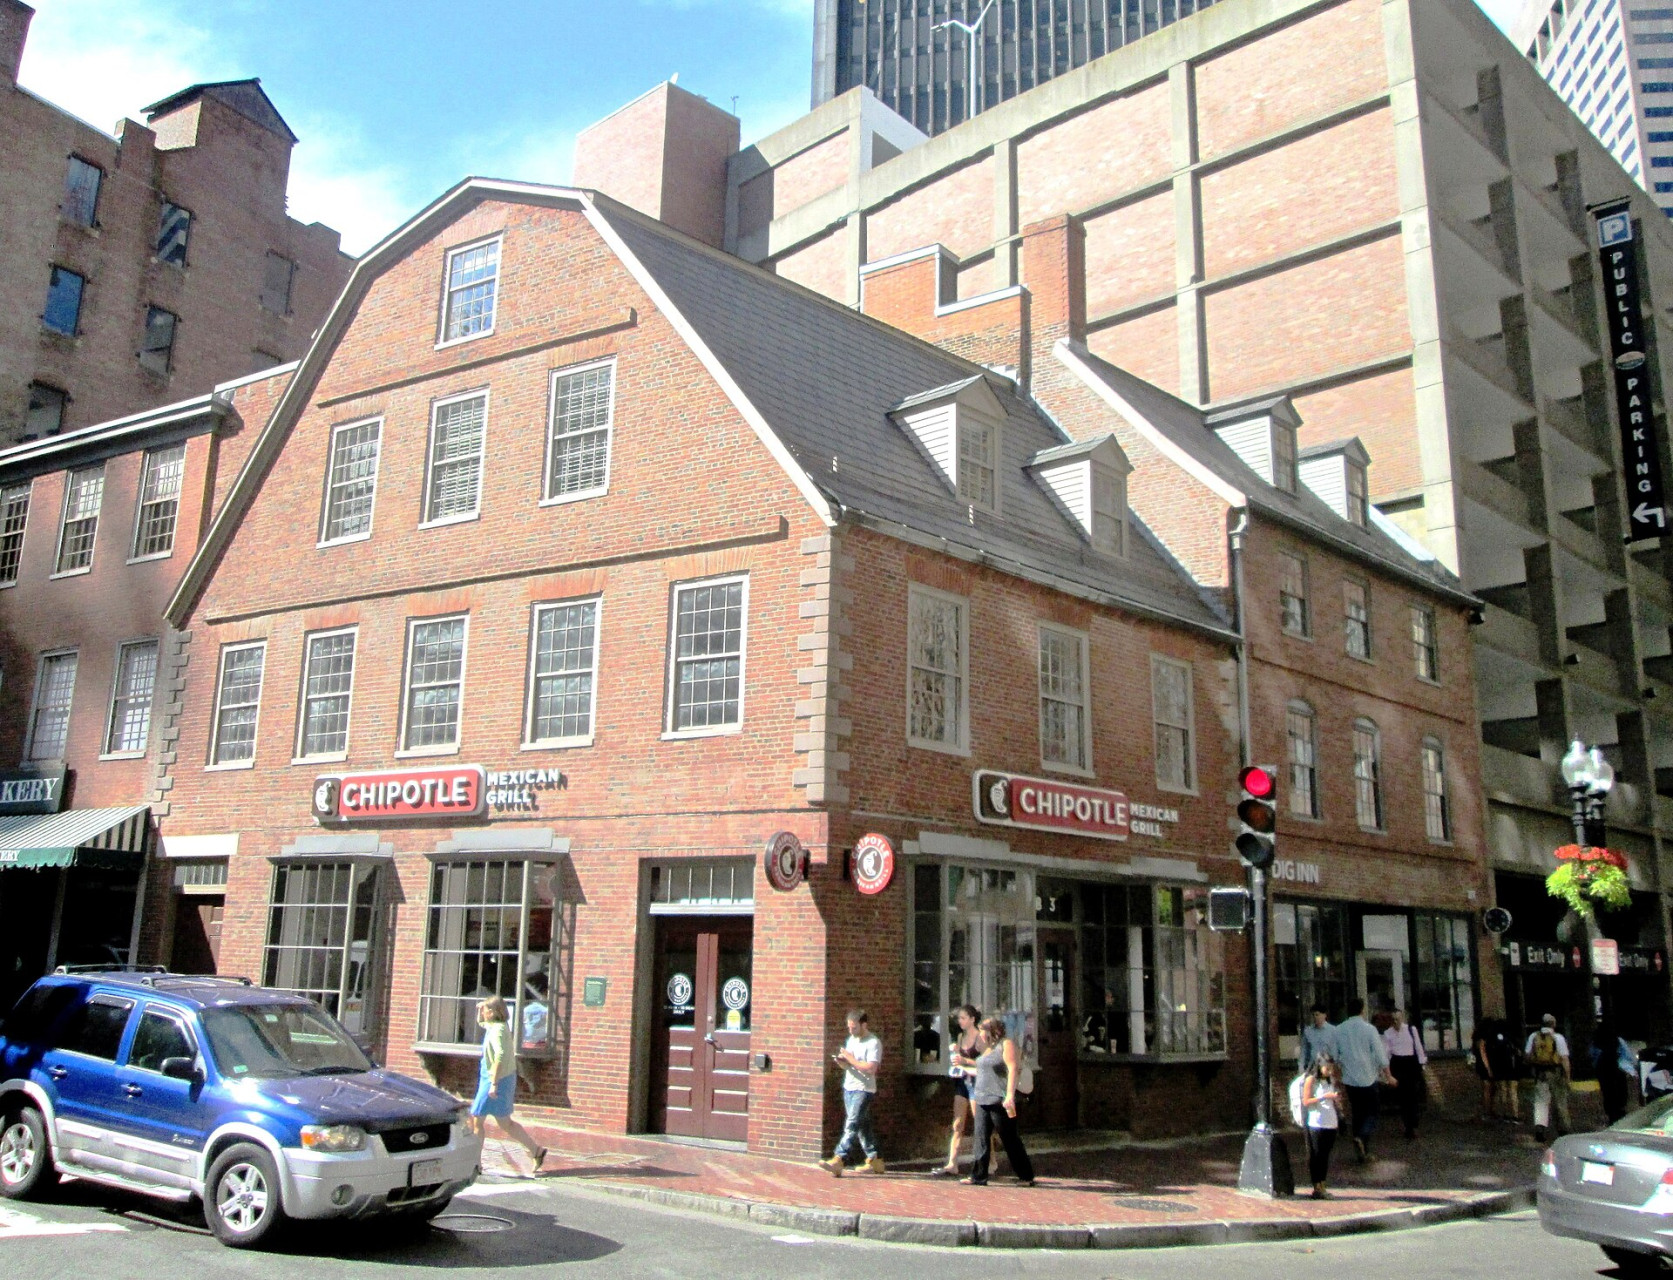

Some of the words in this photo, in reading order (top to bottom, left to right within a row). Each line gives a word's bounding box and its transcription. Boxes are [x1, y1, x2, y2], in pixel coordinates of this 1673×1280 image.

[1612, 251, 1633, 345] PUBLIC
[1627, 377, 1652, 493] PARKING
[486, 768, 561, 787] MEXICAN
[342, 776, 469, 808] CHIPOTLE
[485, 789, 532, 805] GRILL
[1020, 788, 1128, 827] CHIPOTLE
[1130, 802, 1179, 823] MEXICAN
[1130, 820, 1163, 838] GRILL
[1271, 860, 1295, 881] DIG
[1296, 862, 1319, 883] INN
